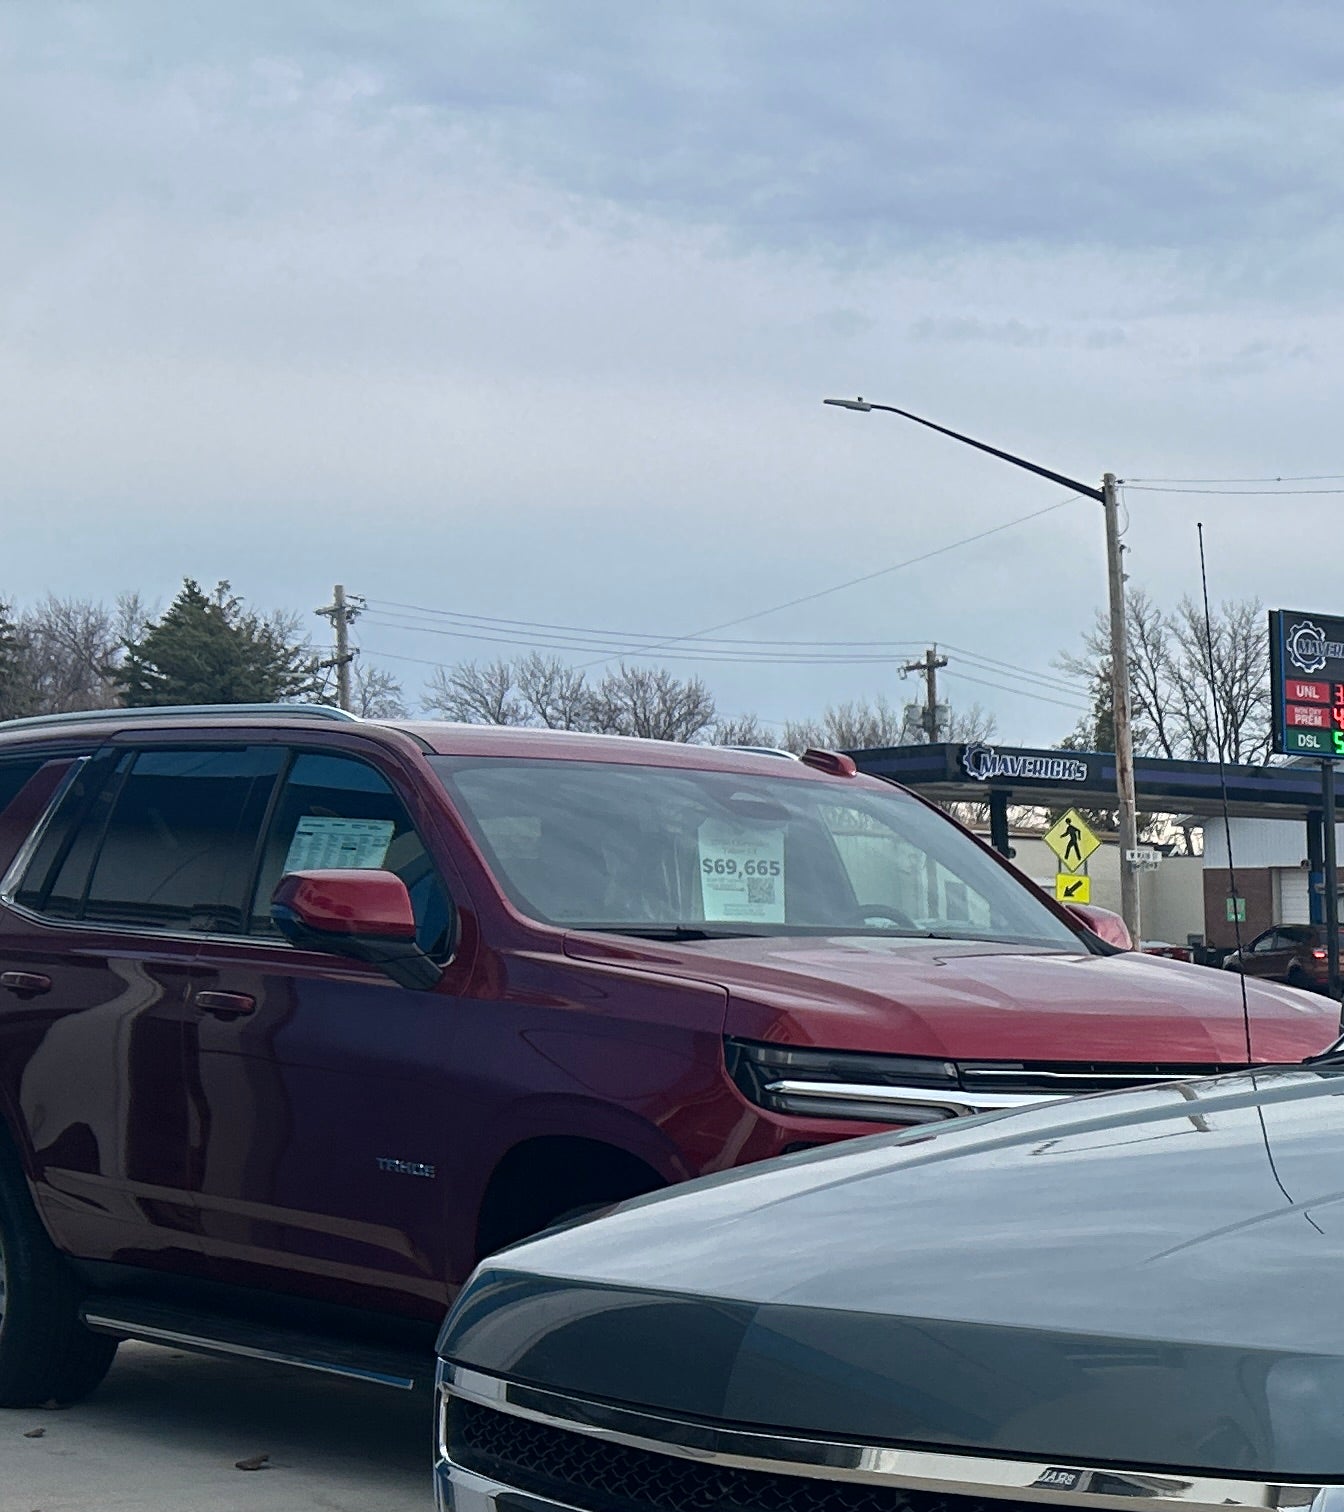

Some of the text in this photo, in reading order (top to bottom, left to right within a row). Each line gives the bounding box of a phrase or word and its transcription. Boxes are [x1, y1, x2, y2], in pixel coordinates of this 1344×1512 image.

[1296, 685, 1320, 699] UNL
[1294, 714, 1323, 727] PREM
[1298, 734, 1321, 749] DSL
[702, 858, 781, 879] $69,665
[375, 1156, 436, 1179] TAHOE
